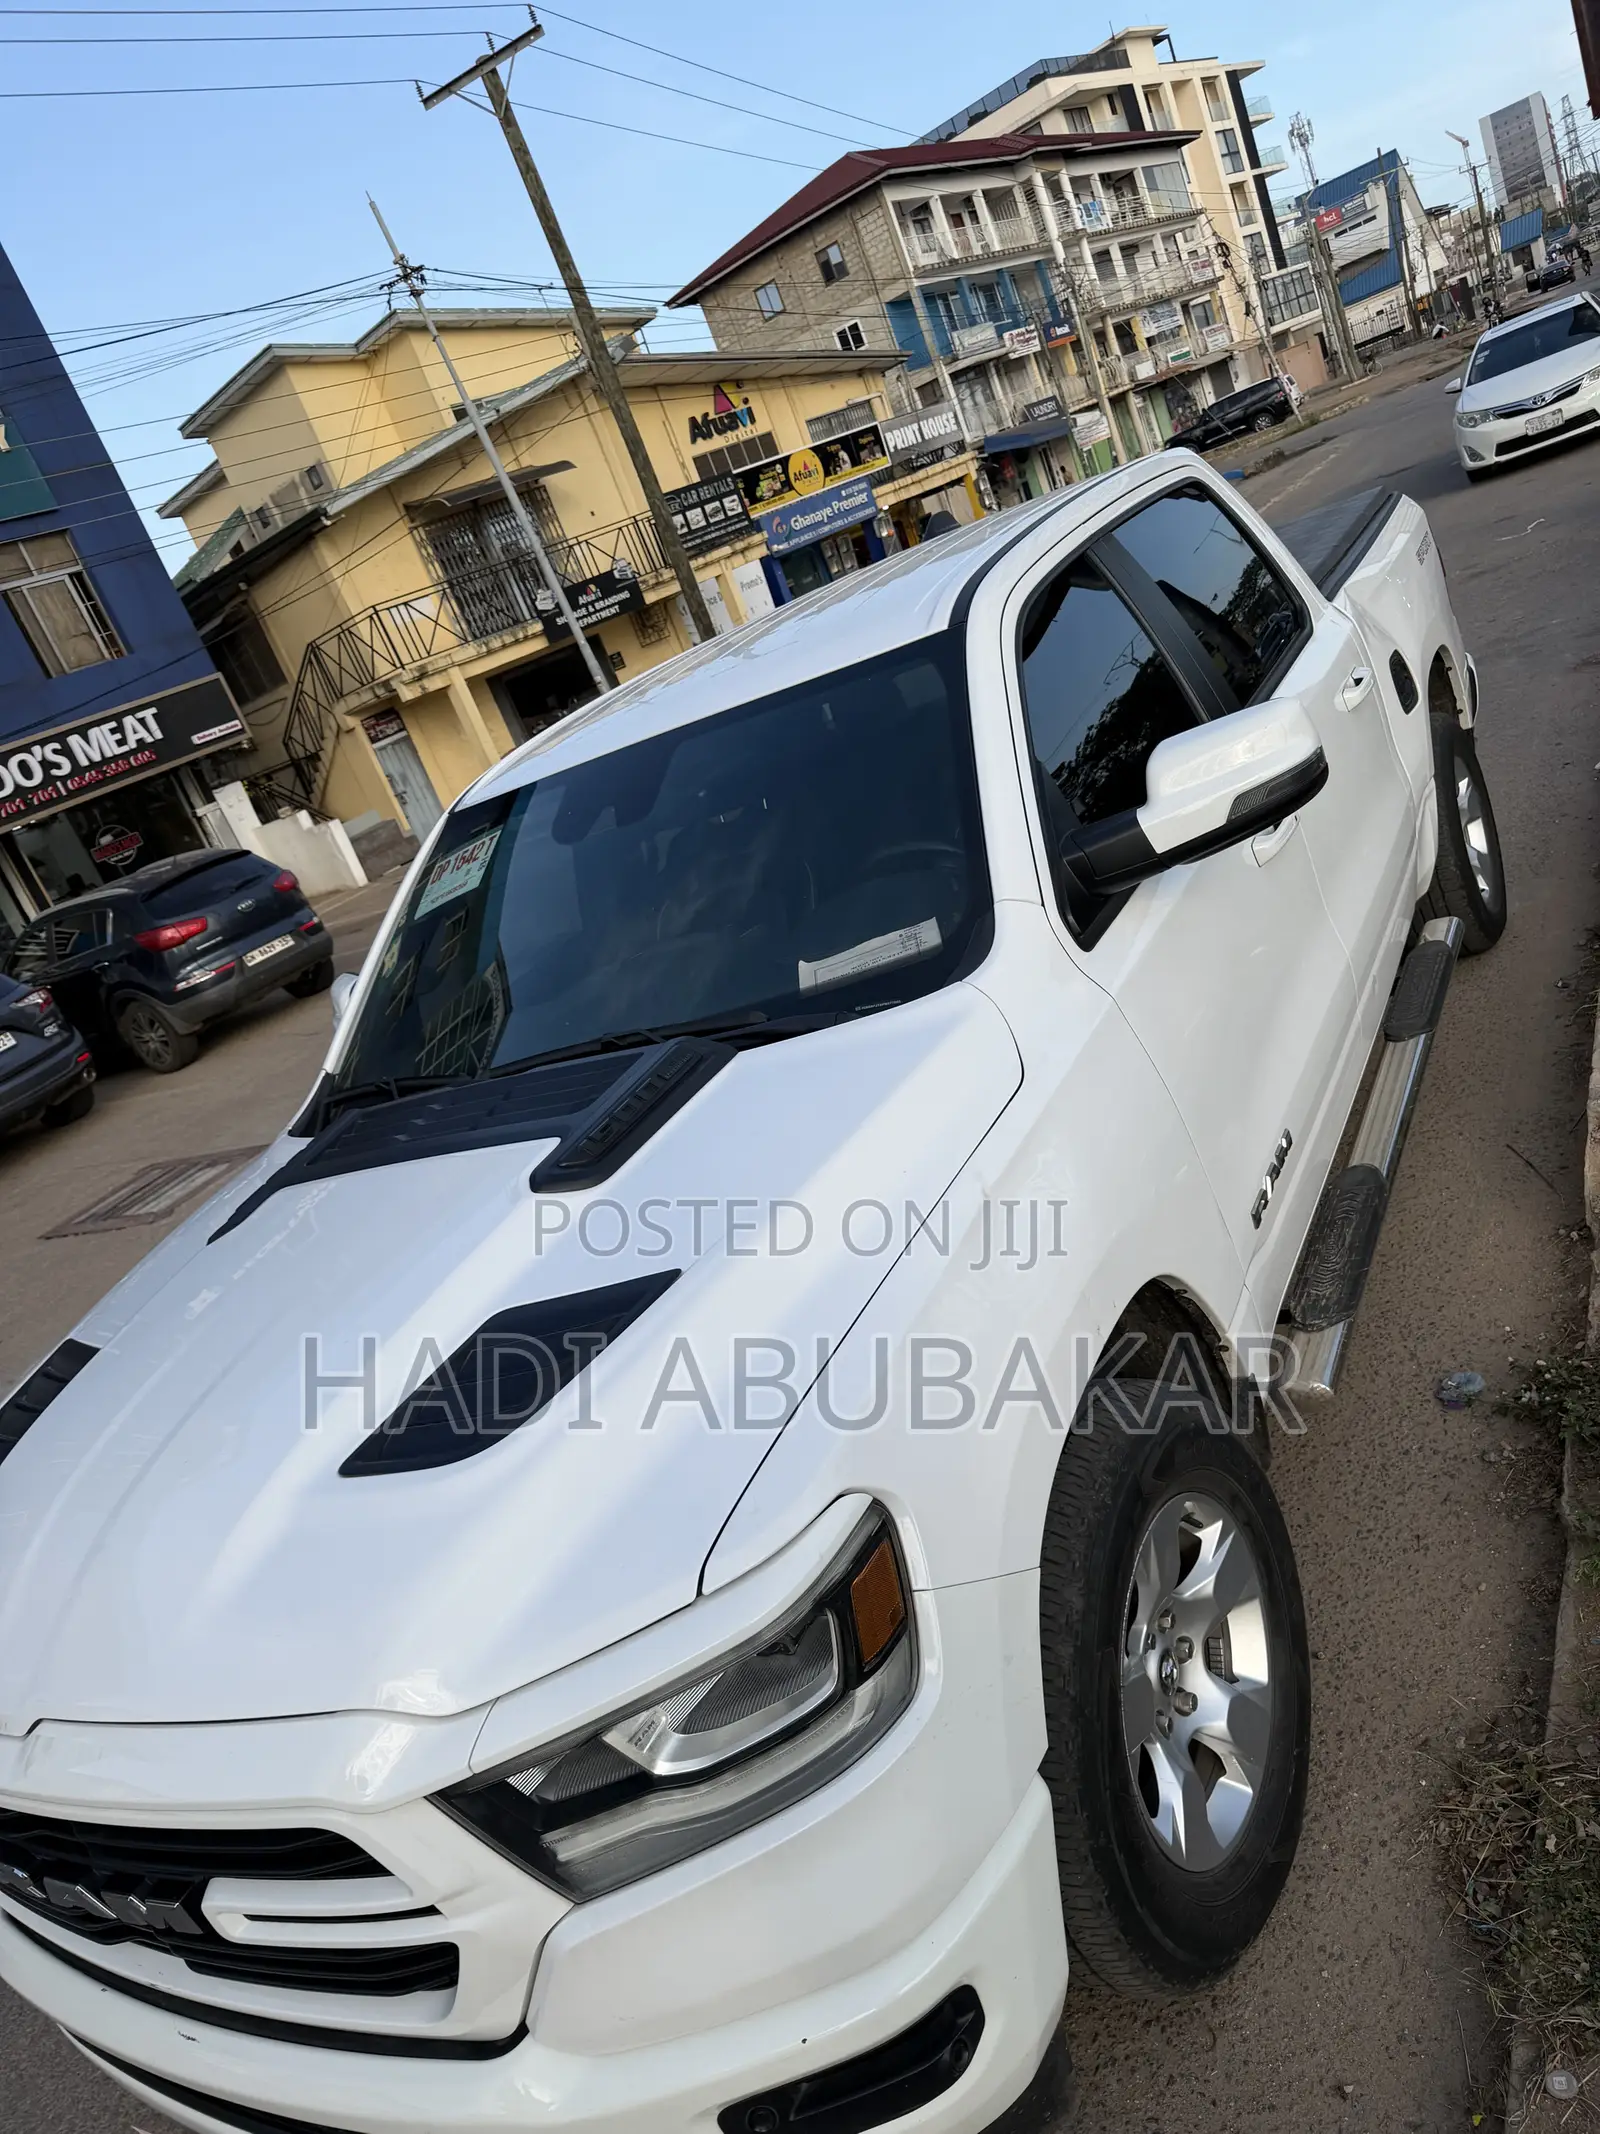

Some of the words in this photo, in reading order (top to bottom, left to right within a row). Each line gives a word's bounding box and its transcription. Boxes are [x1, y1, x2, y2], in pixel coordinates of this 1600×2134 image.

[688, 402, 757, 445] Afuavi
[1030, 400, 1058, 418] LAUNDRY
[884, 422, 922, 453] PRINT
[919, 411, 958, 440] HOUSE
[793, 465, 819, 483] Afuavi
[680, 489, 700, 507] CAR
[698, 477, 735, 500] RENTALS
[790, 506, 834, 531] Ghanaye
[831, 491, 868, 513] Premier
[555, 607, 588, 625] SIGAGE
[594, 590, 631, 610] BRANDING
[578, 605, 620, 627] EPARTMENT
[66, 707, 164, 767] MEAT
